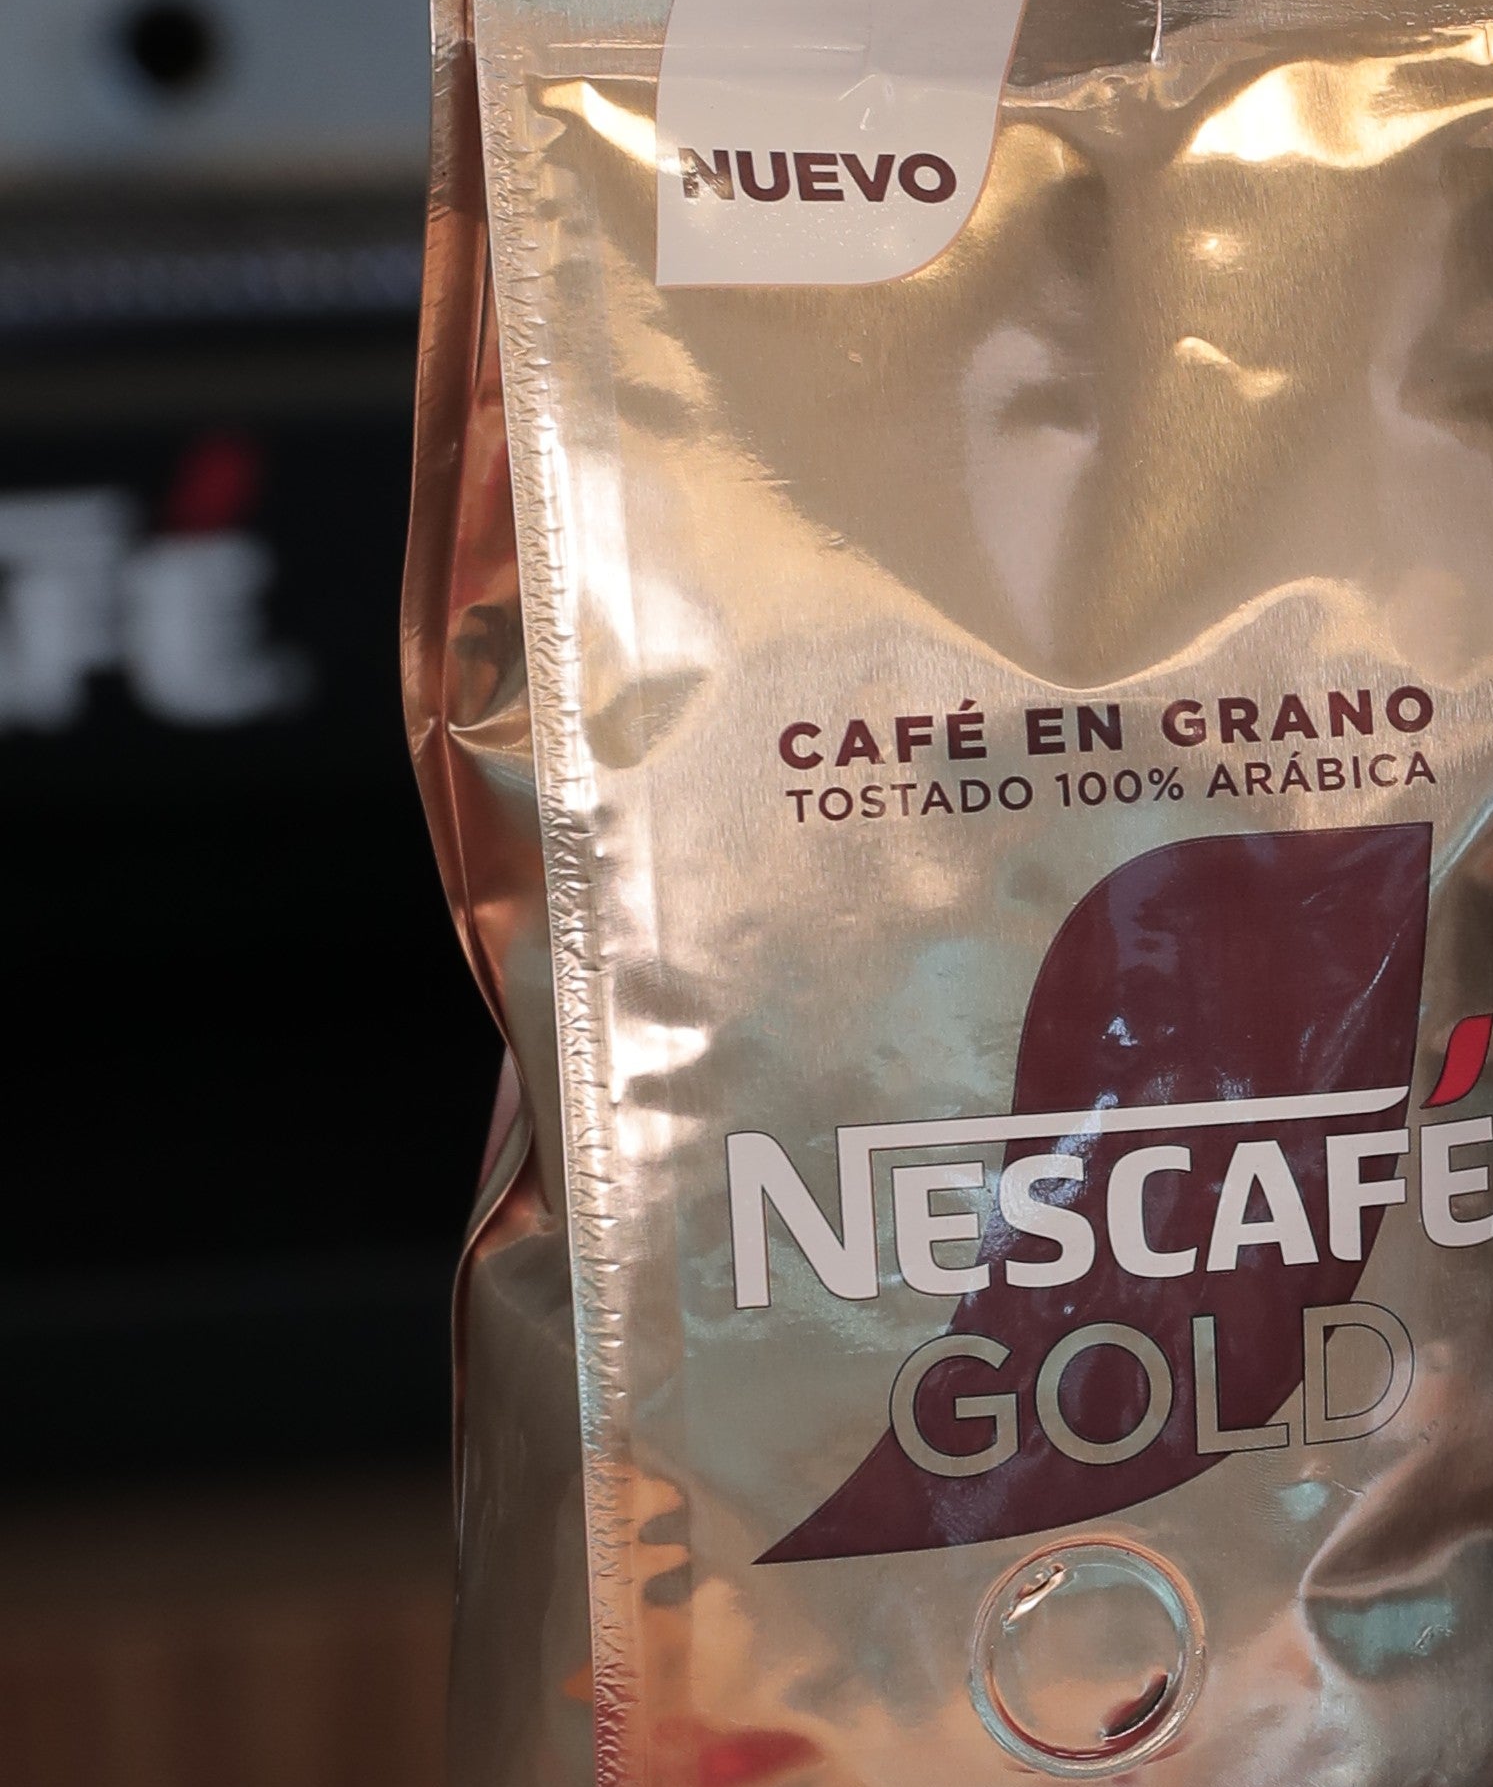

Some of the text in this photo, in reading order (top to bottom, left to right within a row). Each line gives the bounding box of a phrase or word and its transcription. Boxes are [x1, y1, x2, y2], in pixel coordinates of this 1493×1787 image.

[678, 147, 957, 203] NUEVO
[778, 685, 1434, 770] CAFÉ EN GRANO
[785, 751, 1437, 823] TOSTADO 100% ARÁBICA
[889, 1301, 1415, 1479] GOLD
